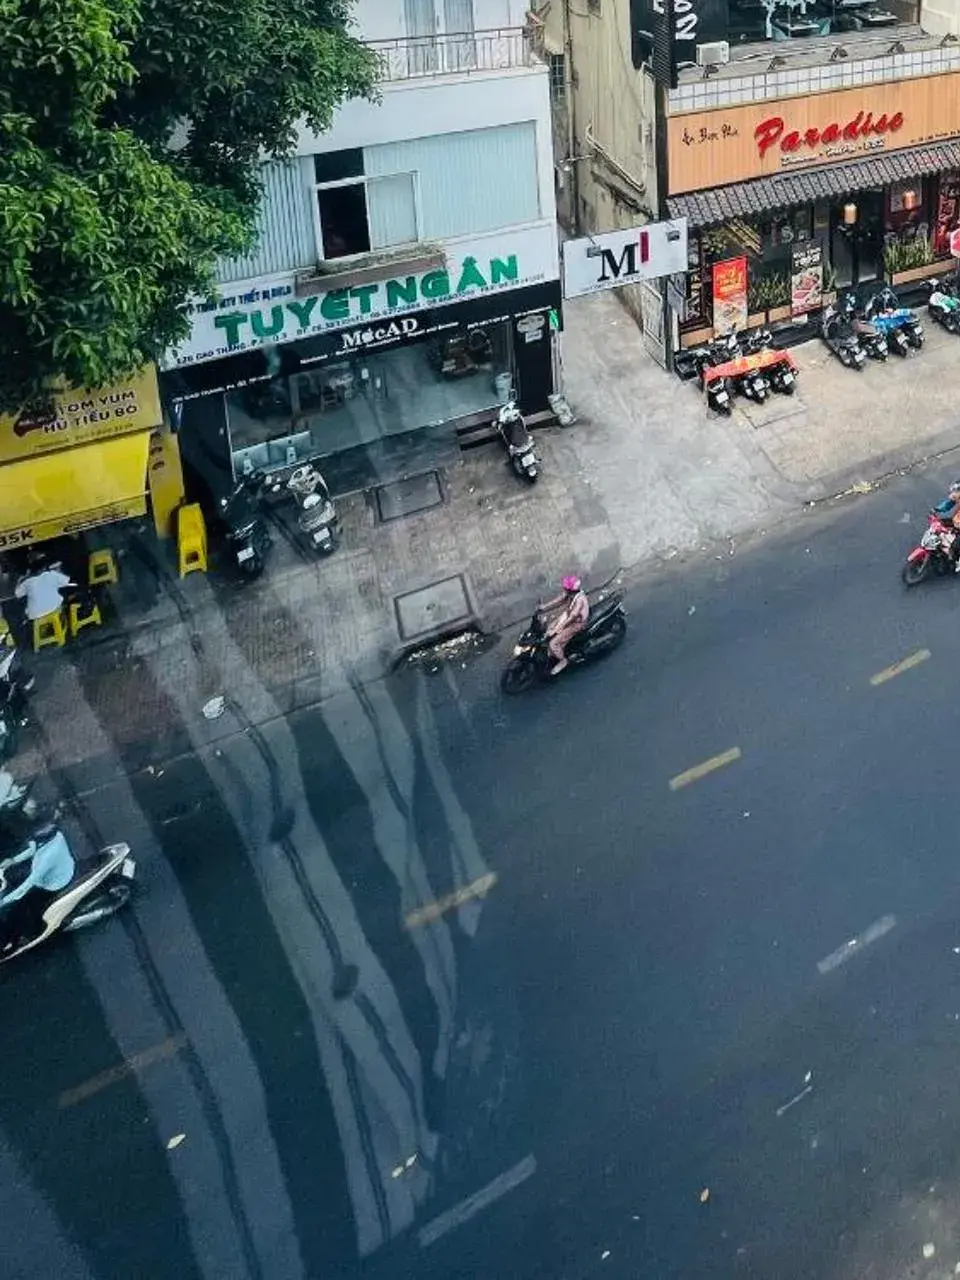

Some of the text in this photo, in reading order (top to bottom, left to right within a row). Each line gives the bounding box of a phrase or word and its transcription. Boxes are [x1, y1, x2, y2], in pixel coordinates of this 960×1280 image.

[754, 111, 904, 160] Paradise
[385, 254, 519, 308] NGÂN
[99, 390, 136, 405] YUM
